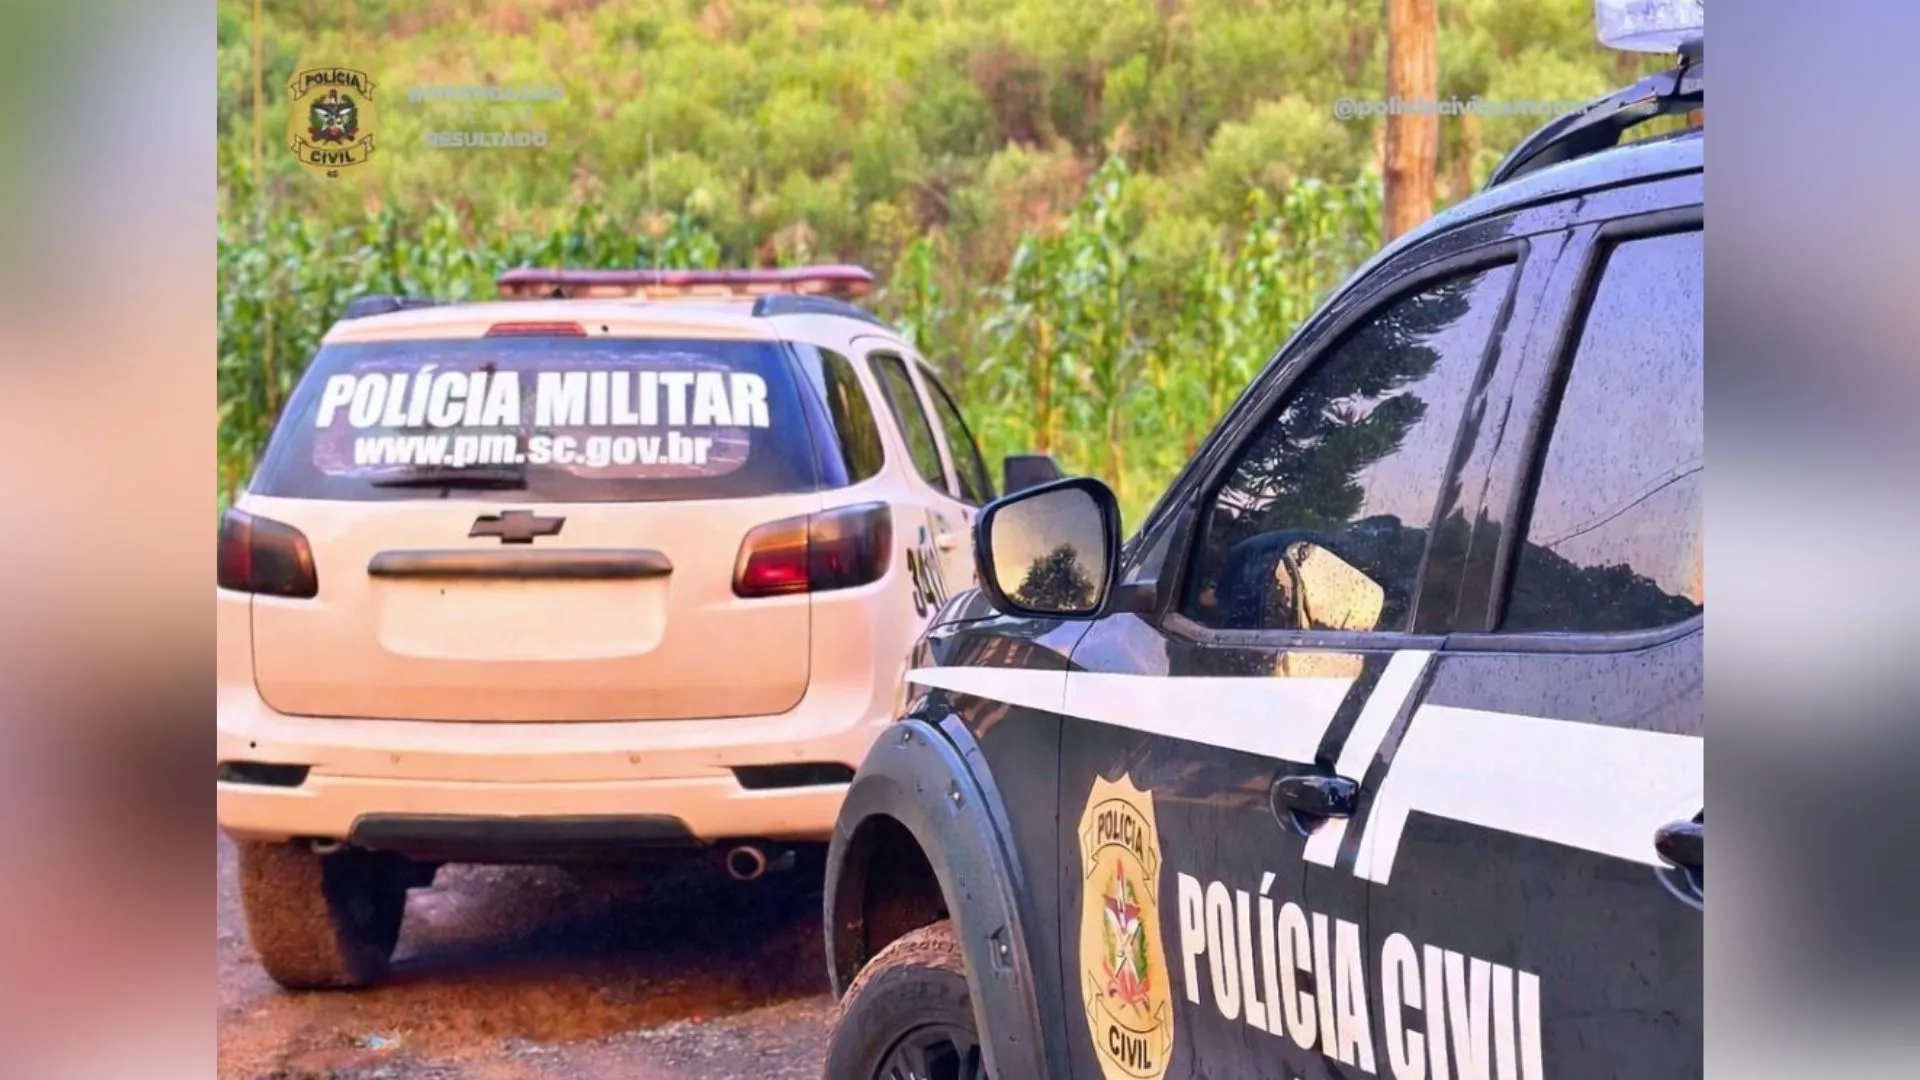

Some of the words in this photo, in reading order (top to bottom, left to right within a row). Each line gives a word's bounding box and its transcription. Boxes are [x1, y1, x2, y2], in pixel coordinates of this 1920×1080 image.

[315, 364, 522, 428] POLÍCIA
[536, 370, 770, 429] MILITAR
[354, 430, 713, 468] www.pm.sc.gov.br
[1097, 804, 1145, 857] POLÍCIA
[1177, 872, 1377, 1075] POLÍCIA
[1108, 1027, 1153, 1070] CIVIL
